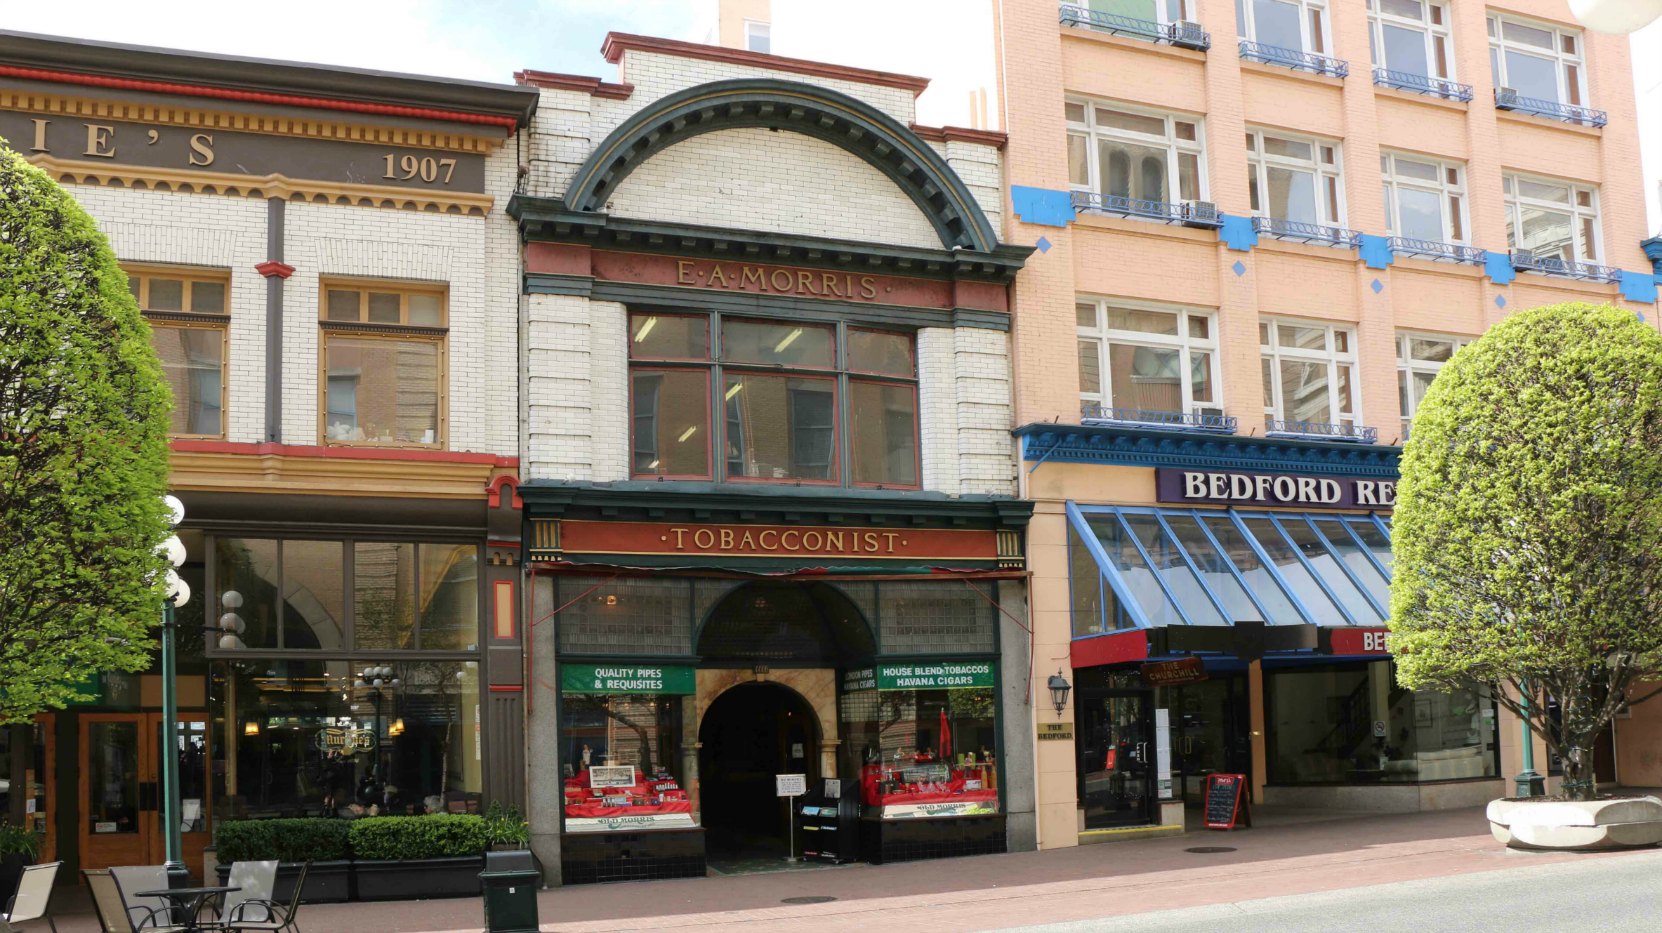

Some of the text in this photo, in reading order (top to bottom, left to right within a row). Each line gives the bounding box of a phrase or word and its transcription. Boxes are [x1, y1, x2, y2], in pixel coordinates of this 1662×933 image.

[383, 153, 457, 184] 1907
[1184, 471, 1342, 504] BEDFORD
[670, 527, 900, 552] TOBACCONIST
[883, 665, 989, 676] HOUSE BLEND TOBACCOS
[1161, 661, 1180, 671] THE
[595, 668, 662, 678] QUALITY PIPES
[1149, 667, 1200, 681] CHURCHILL
[594, 680, 663, 690] & REQUISITES
[896, 676, 973, 687] HAVANA CIGARS
[1047, 724, 1062, 732] THE
